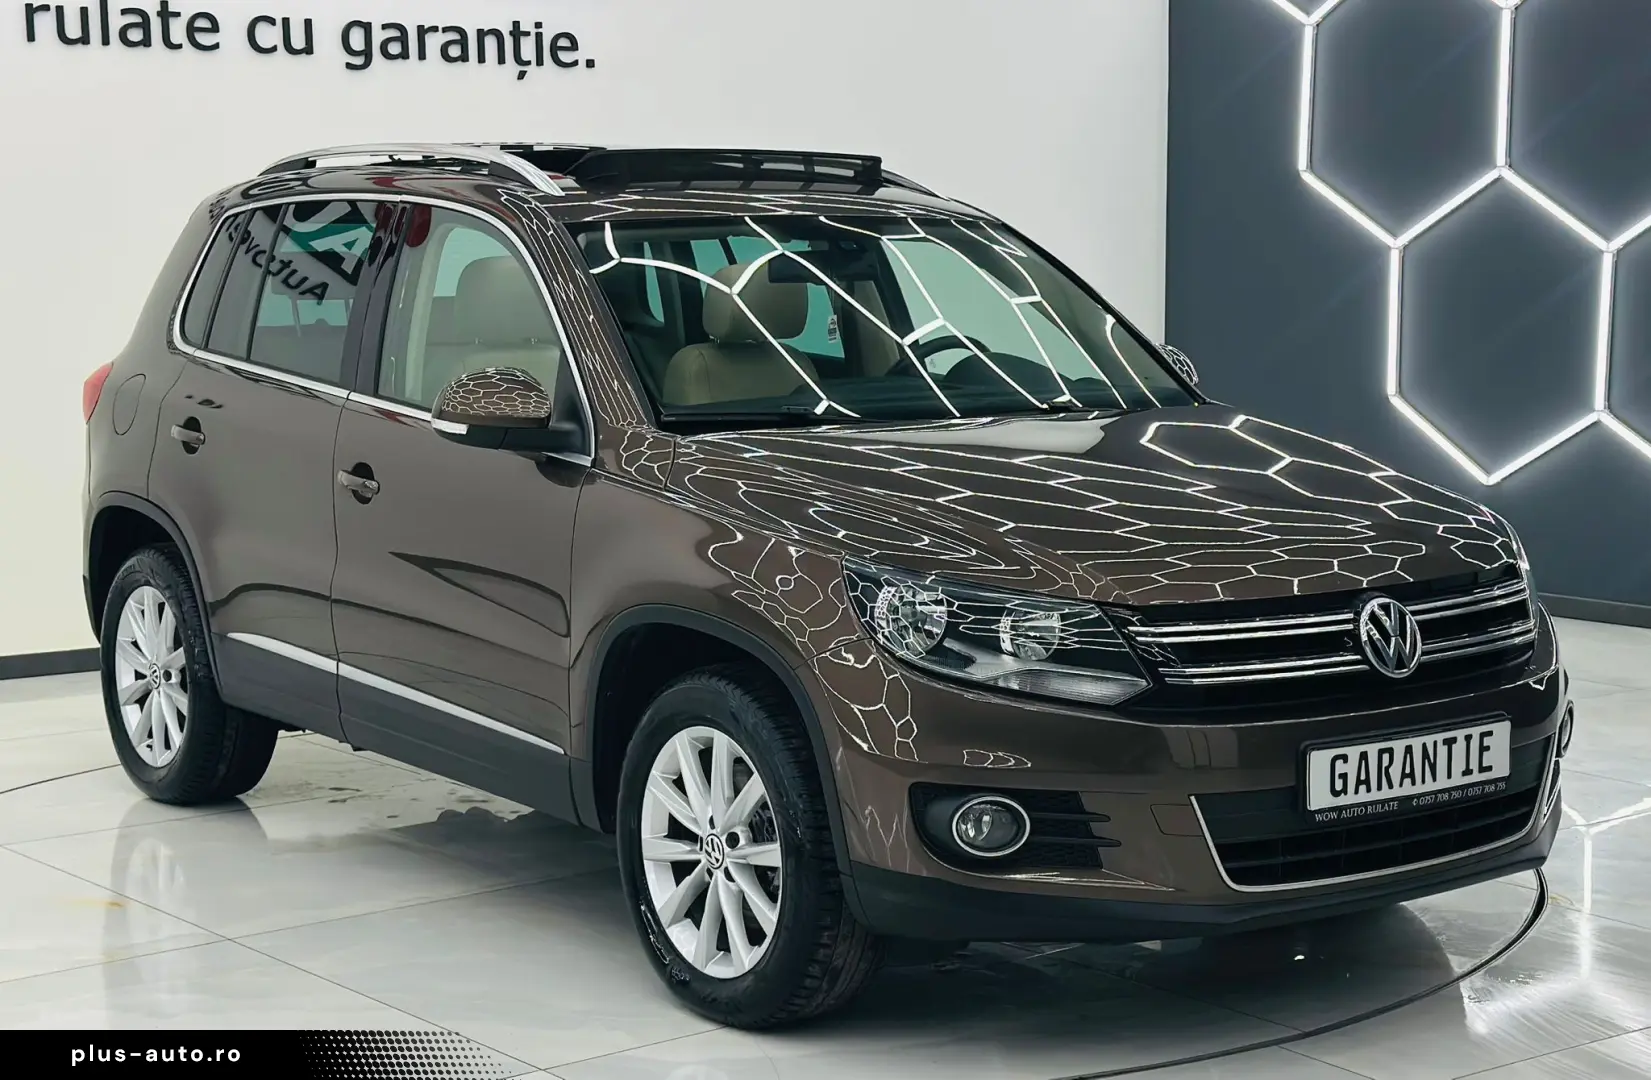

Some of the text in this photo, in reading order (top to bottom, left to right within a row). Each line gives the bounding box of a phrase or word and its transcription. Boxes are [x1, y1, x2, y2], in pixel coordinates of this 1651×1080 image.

[24, 0, 596, 81] rulate cu garanție.
[1329, 730, 1494, 798] GARANTIE
[1314, 801, 1399, 822] WOW AUTO RULATE
[1419, 795, 1435, 806] 0757
[1467, 786, 1483, 797] 0757
